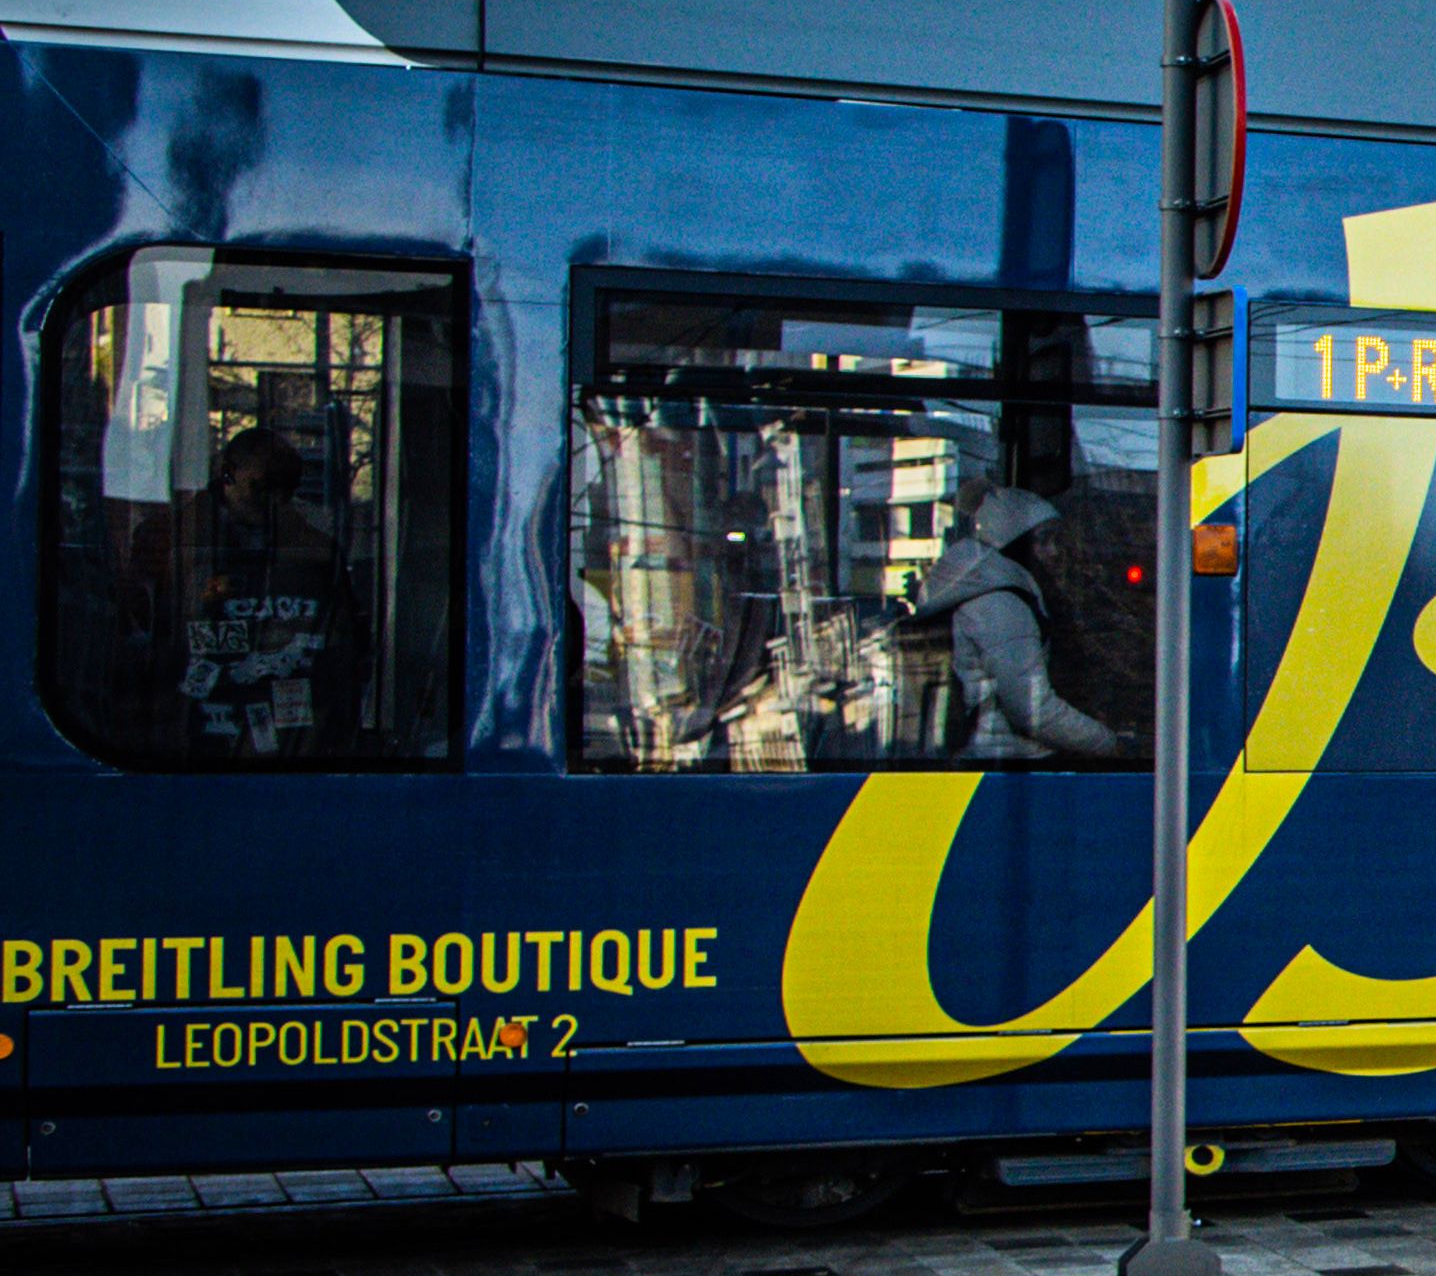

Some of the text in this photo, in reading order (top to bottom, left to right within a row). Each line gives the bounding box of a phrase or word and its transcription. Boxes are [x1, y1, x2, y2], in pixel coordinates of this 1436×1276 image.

[1313, 334, 1333, 401] 1
[2, 927, 718, 1004] BREITLING BOUTIQUE
[155, 1014, 578, 1069] LEOPOLDSTRAAT 2
